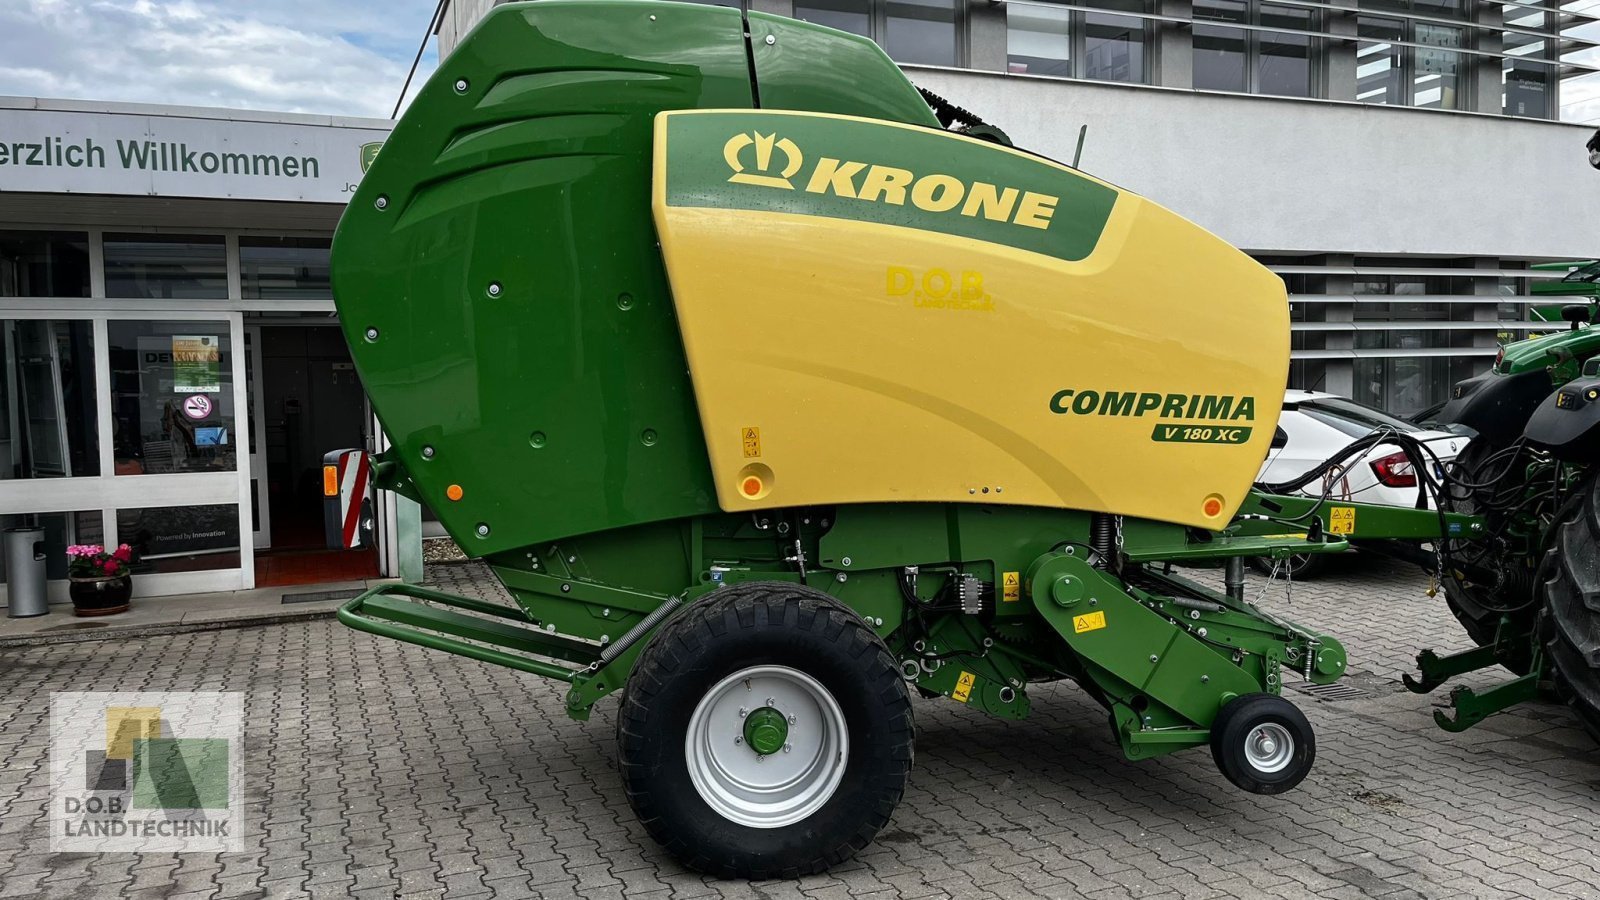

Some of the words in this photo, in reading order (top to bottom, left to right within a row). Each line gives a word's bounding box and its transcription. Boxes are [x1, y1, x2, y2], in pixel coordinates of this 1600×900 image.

[0, 136, 105, 168] erzlich
[116, 139, 319, 178] Willkommen
[805, 157, 1059, 230] KRONE
[887, 266, 992, 302] D.O.B.
[1050, 389, 1255, 421] COMPRIMA
[1165, 427, 1178, 439] V
[1183, 428, 1212, 440] 180
[1215, 429, 1242, 441] XC
[192, 530, 226, 539] Innovation
